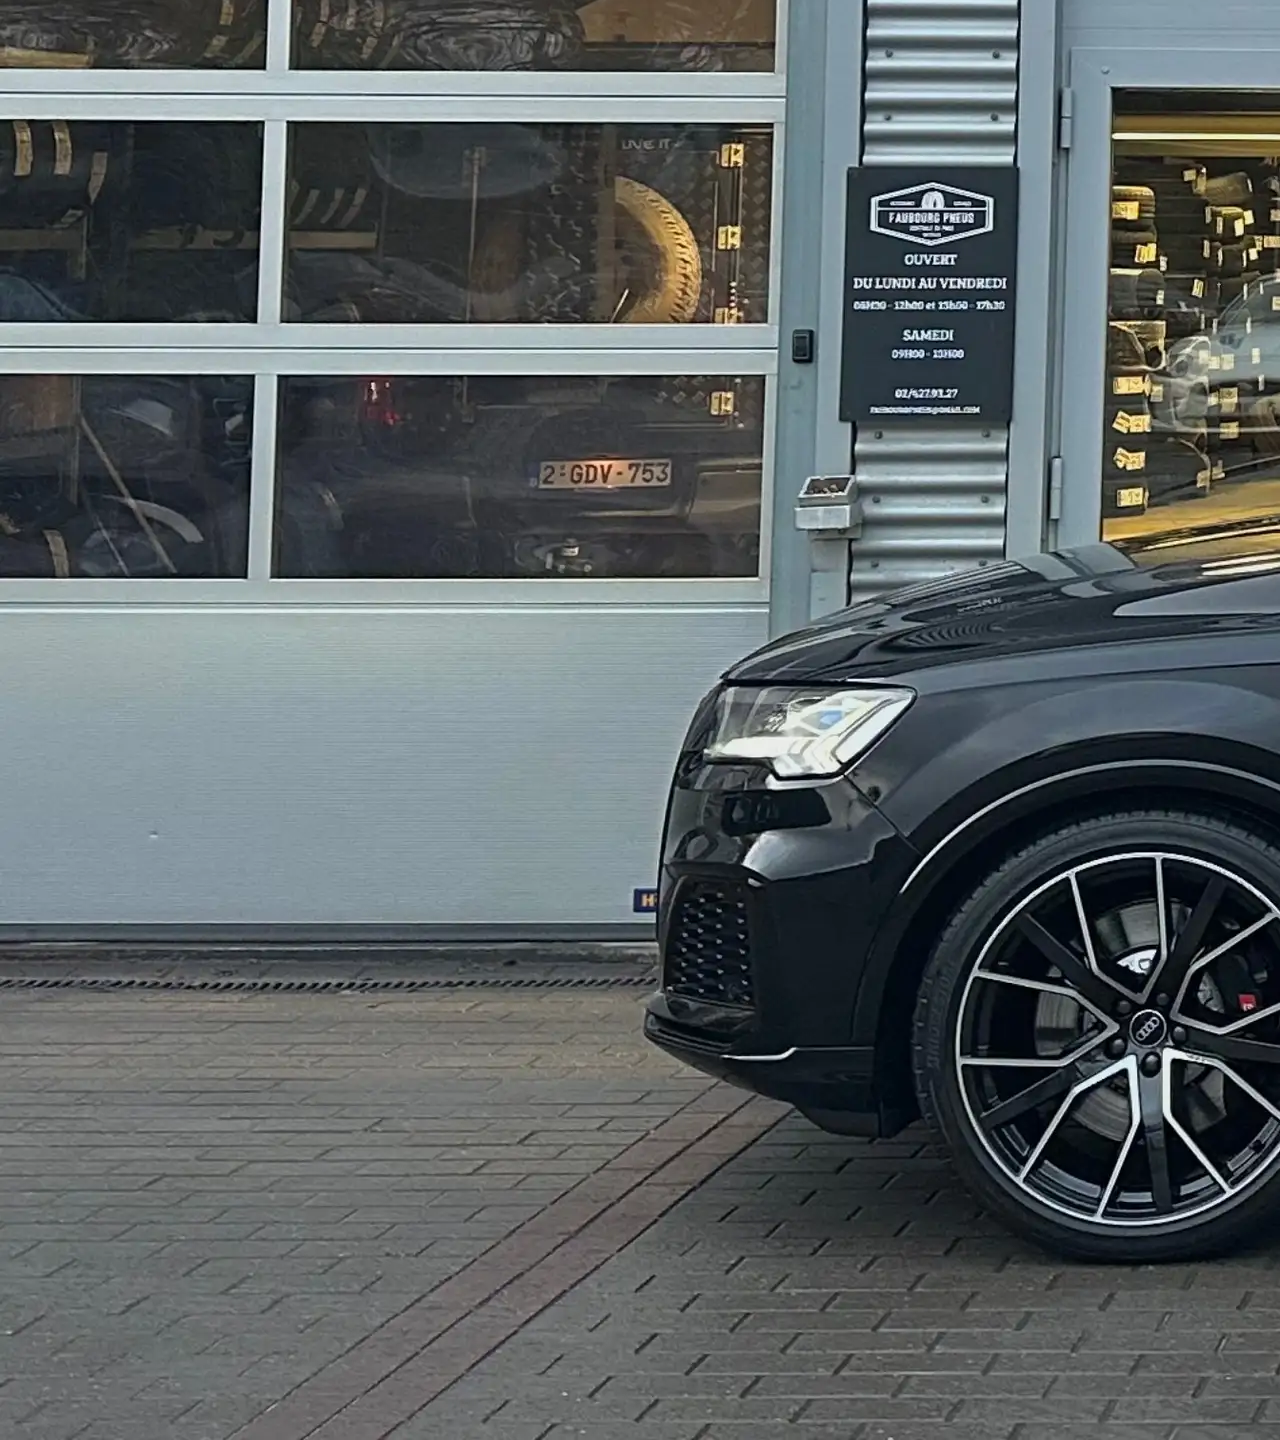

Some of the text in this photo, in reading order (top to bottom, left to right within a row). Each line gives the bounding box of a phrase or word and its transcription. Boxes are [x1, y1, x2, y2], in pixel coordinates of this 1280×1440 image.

[904, 254, 958, 266] OUVERT
[853, 277, 1007, 290] DU LUNDI AU VENDREDI
[925, 301, 938, 311] et
[902, 329, 954, 342] SAMEDI
